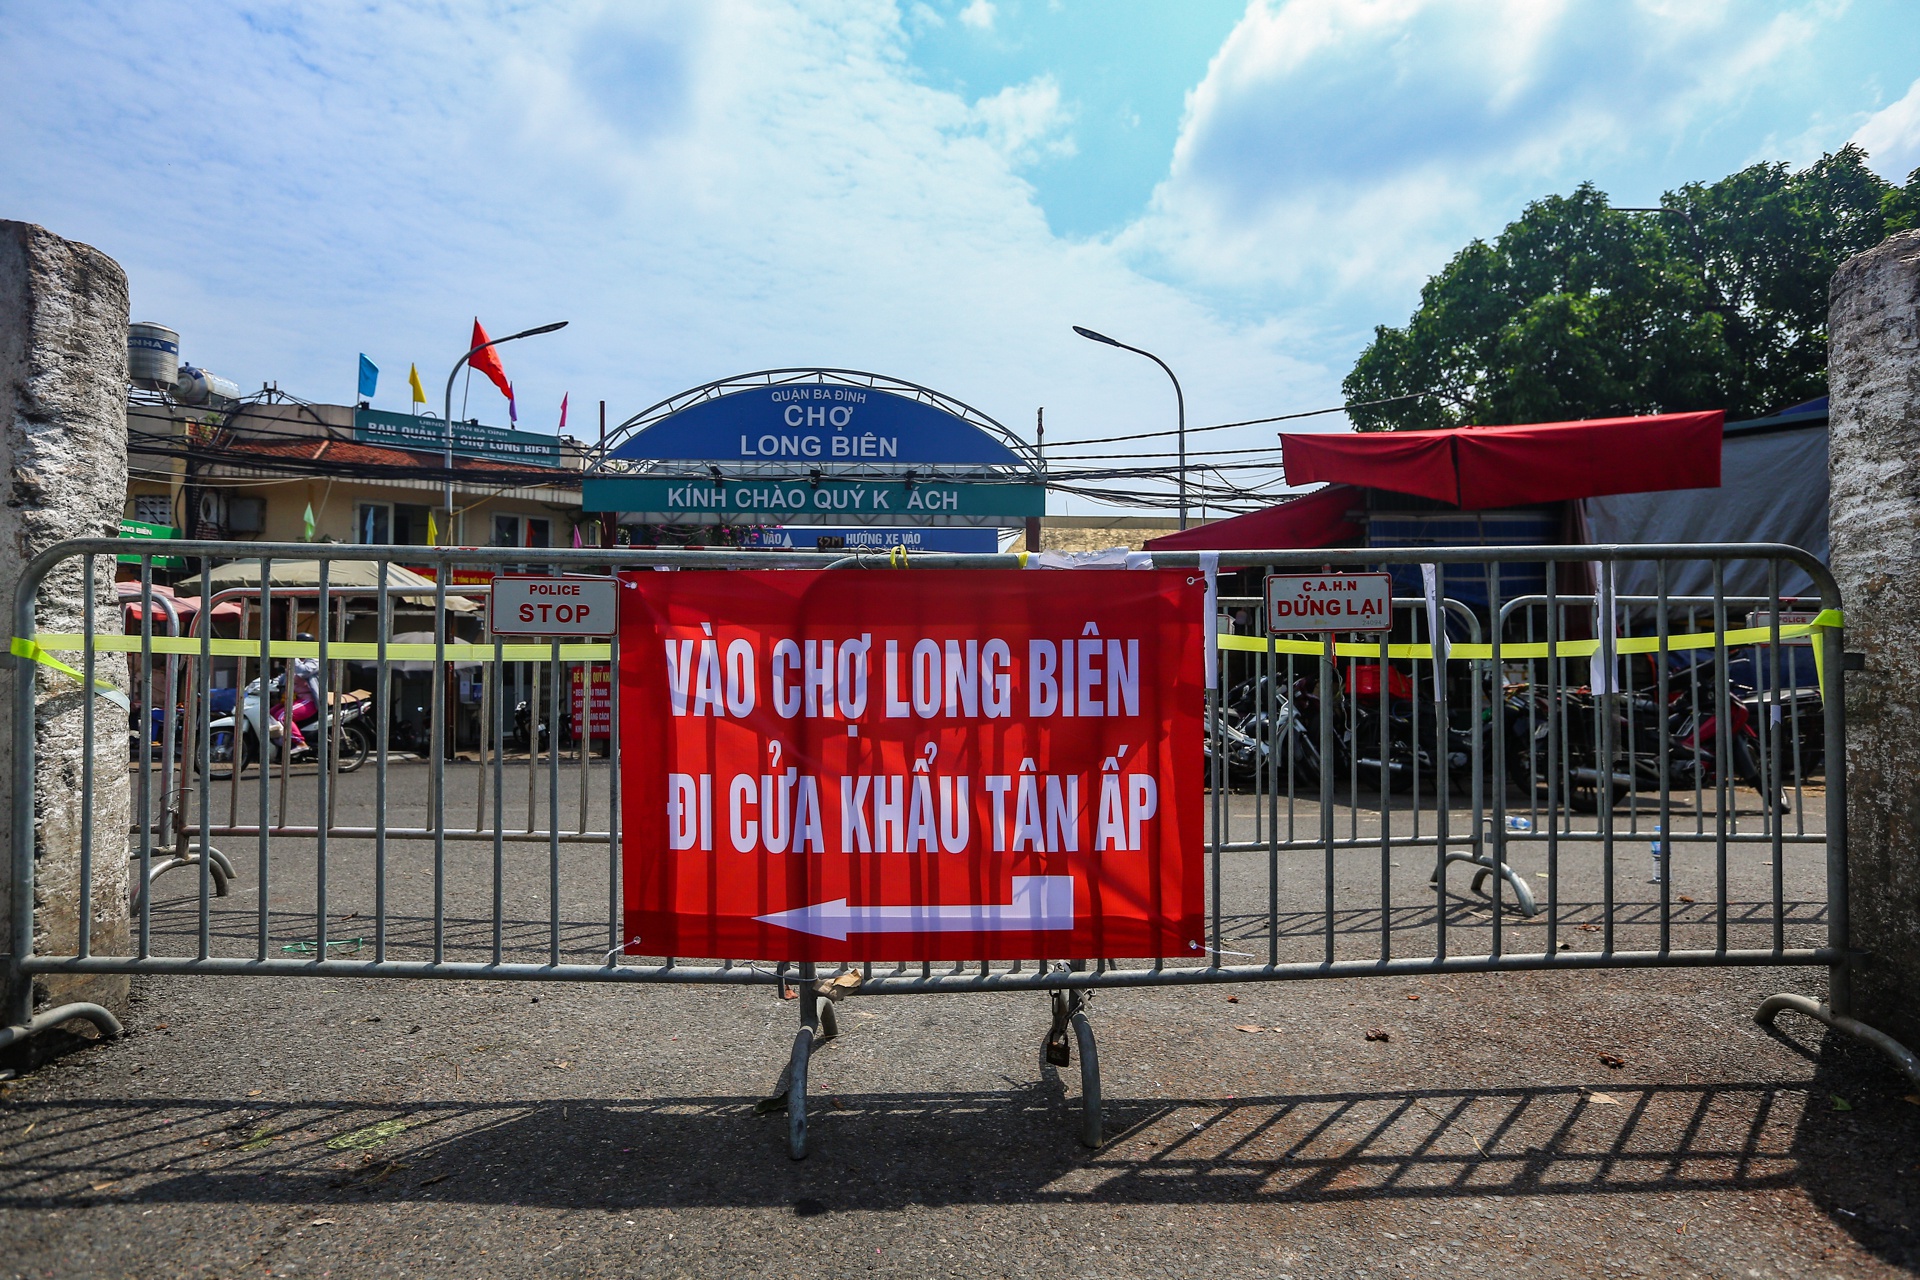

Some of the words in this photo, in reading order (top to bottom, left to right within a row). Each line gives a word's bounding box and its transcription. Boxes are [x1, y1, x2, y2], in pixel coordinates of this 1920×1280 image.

[771, 388, 809, 402] QUẬN
[814, 388, 832, 400] BA
[834, 388, 866, 404] ĐÌNH
[784, 404, 854, 431] CHỢ
[368, 422, 396, 436] BAN
[741, 434, 821, 456] LONG
[832, 432, 897, 457] BIÊN
[668, 484, 726, 508] KÍNH
[735, 484, 806, 509] CHÀO
[814, 484, 865, 509] QUÝ
[120, 525, 134, 533] ONG
[763, 531, 781, 544] VÀO
[846, 530, 882, 544] HƯỚNG
[886, 534, 899, 544] XE
[902, 531, 921, 544] VÀO
[530, 585, 580, 595] POLICE
[1302, 581, 1357, 592] C.A.H.N
[519, 604, 590, 623] STOP
[1278, 594, 1341, 616] DỪNG
[1347, 598, 1382, 618] LẠI
[666, 622, 756, 718] VÀO
[772, 633, 872, 738] CHỢ
[885, 638, 1011, 719] LONG
[1028, 621, 1139, 718] BIÊN
[668, 772, 713, 851] ĐI
[729, 740, 825, 854] CỬA
[840, 741, 970, 854] KHẨU
[985, 757, 1078, 852] TÂN
[1095, 744, 1158, 851] ẤP
